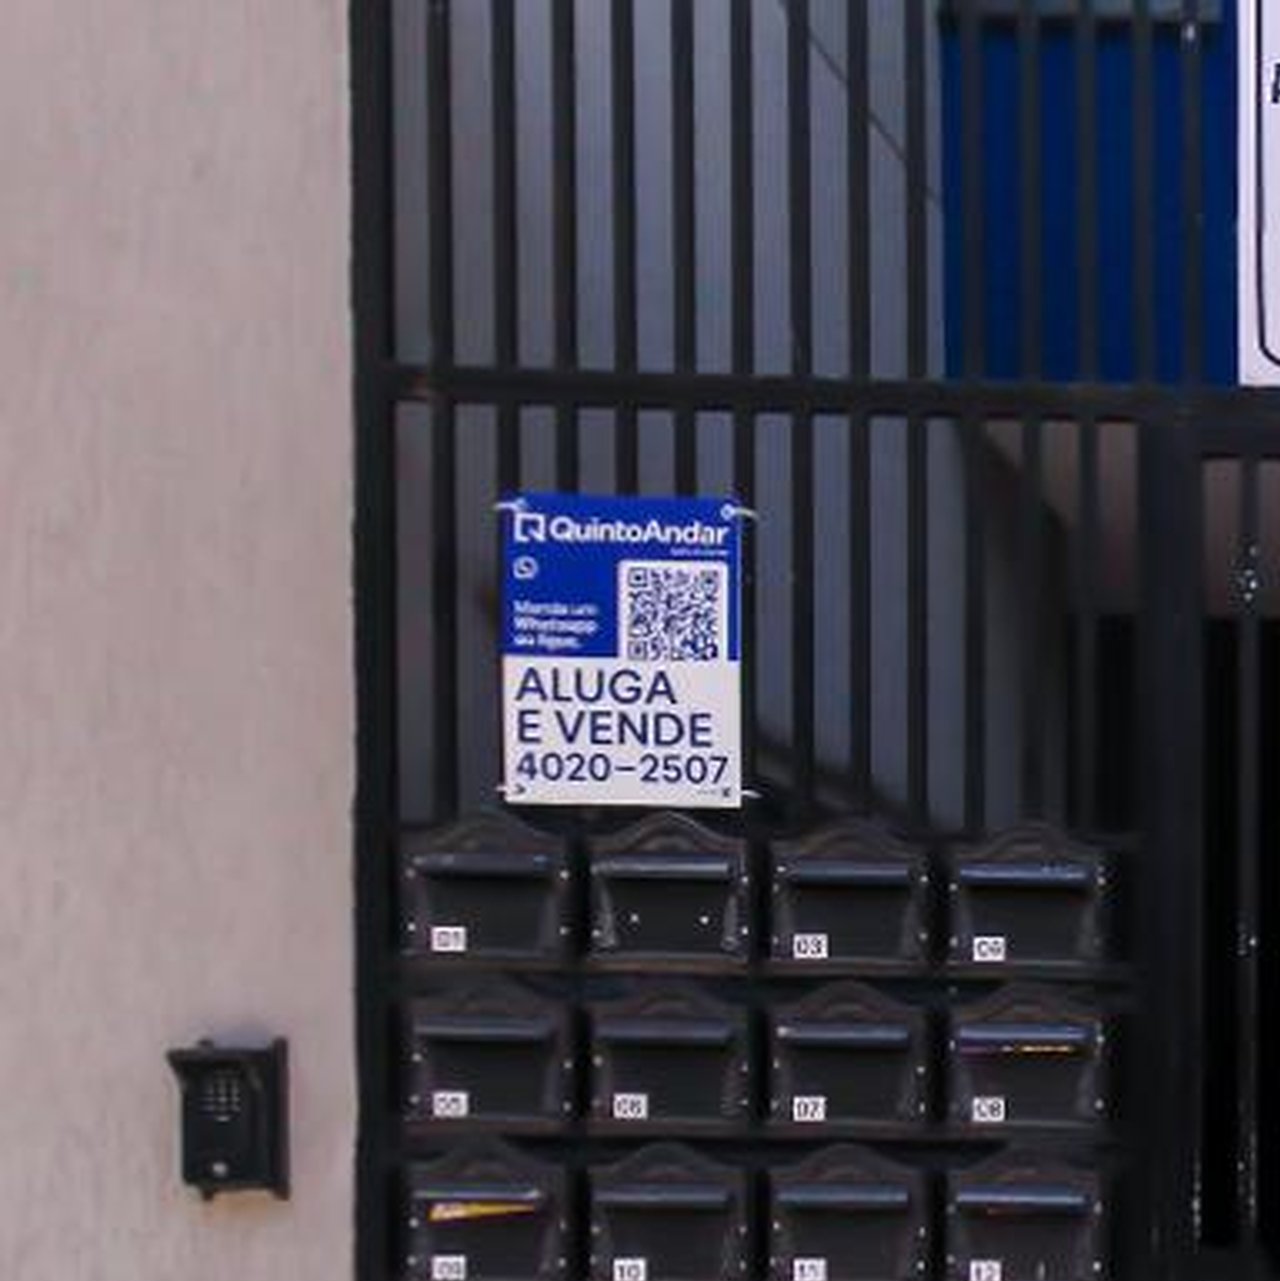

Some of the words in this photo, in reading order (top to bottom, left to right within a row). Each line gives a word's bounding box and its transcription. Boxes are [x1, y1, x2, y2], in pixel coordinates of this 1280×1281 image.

[550, 516, 729, 544] QuintoAndar
[515, 667, 678, 704] ALUGA
[518, 709, 541, 744] E
[555, 710, 713, 748] VENDE
[515, 752, 729, 784] 4020-2507
